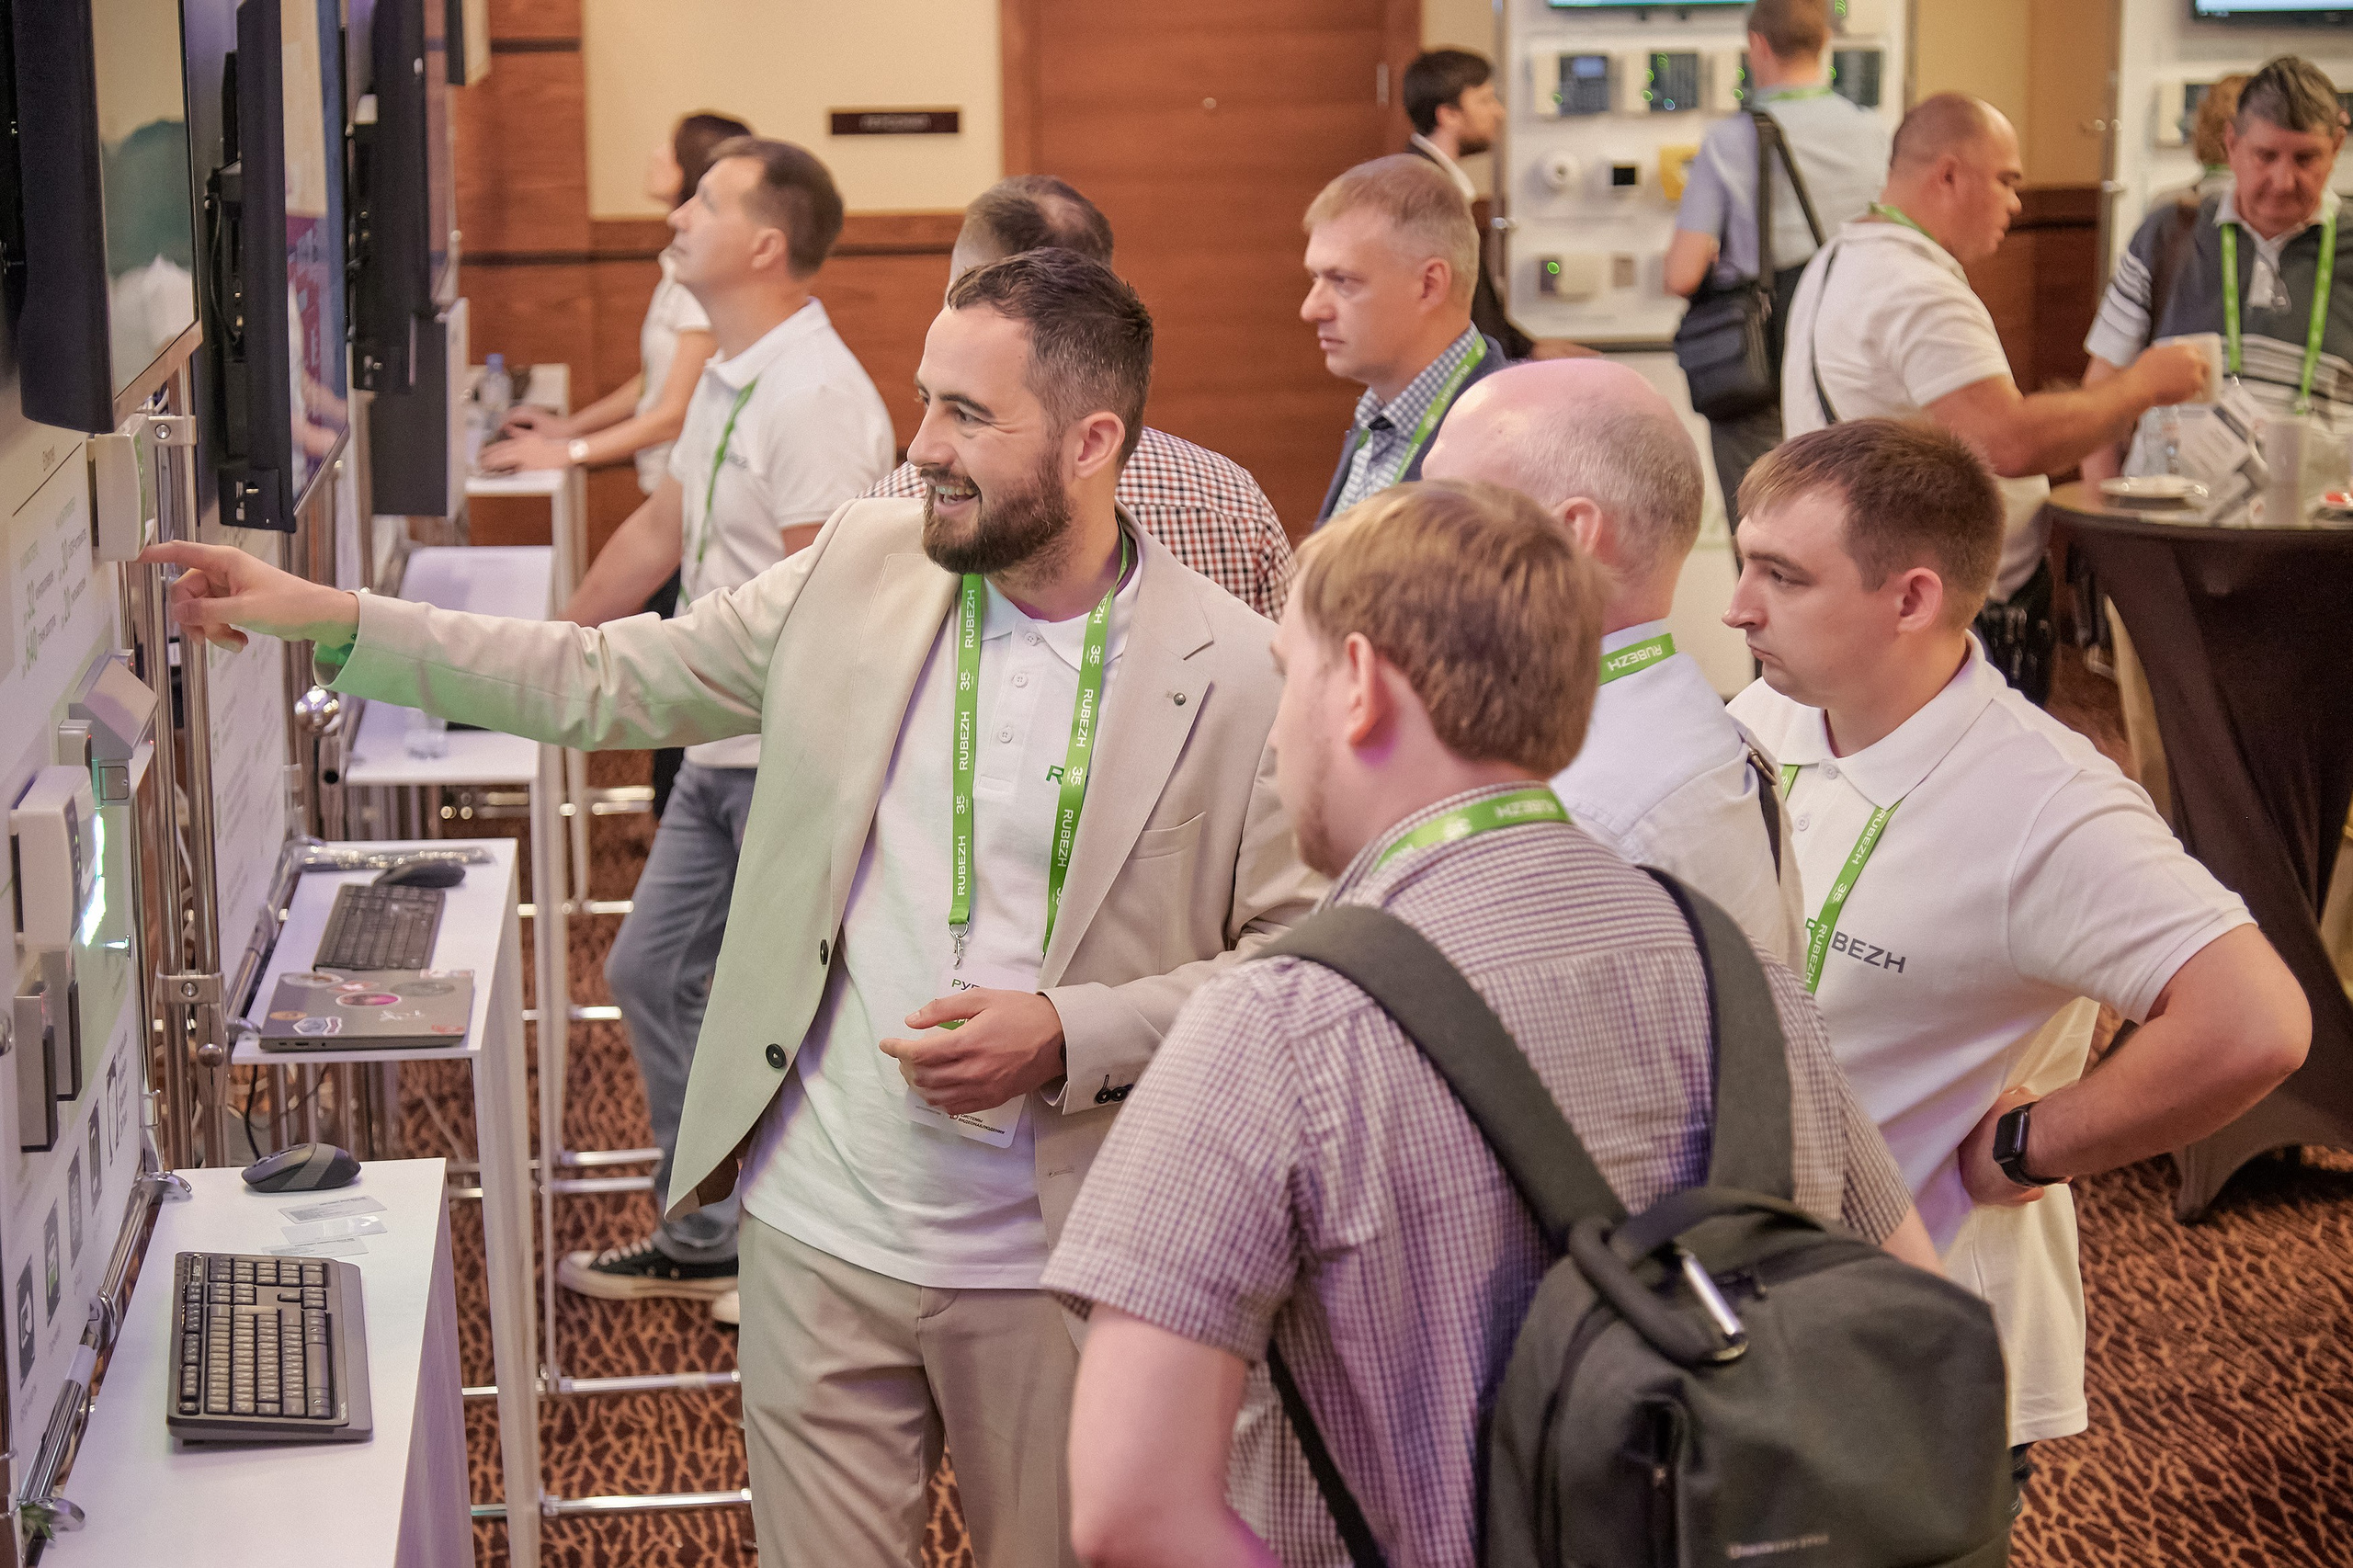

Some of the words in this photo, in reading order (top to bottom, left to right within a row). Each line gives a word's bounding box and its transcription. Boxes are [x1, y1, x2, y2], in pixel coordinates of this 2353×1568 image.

[964, 589, 975, 648] RUBEZH
[1093, 590, 1110, 624] EZH
[961, 671, 971, 691] 35
[1089, 644, 1101, 666] 35
[1607, 644, 1663, 672] RUBEZH
[959, 711, 970, 770] RUBEZH
[1076, 688, 1094, 747] RUBEZH
[956, 793, 965, 814] 35
[1071, 766, 1084, 787] 35
[958, 835, 966, 895] RUBEZH
[1057, 809, 1074, 868] RUBEZH
[1851, 810, 1887, 865] RUBEZH
[1804, 924, 1828, 984] RUBEZH
